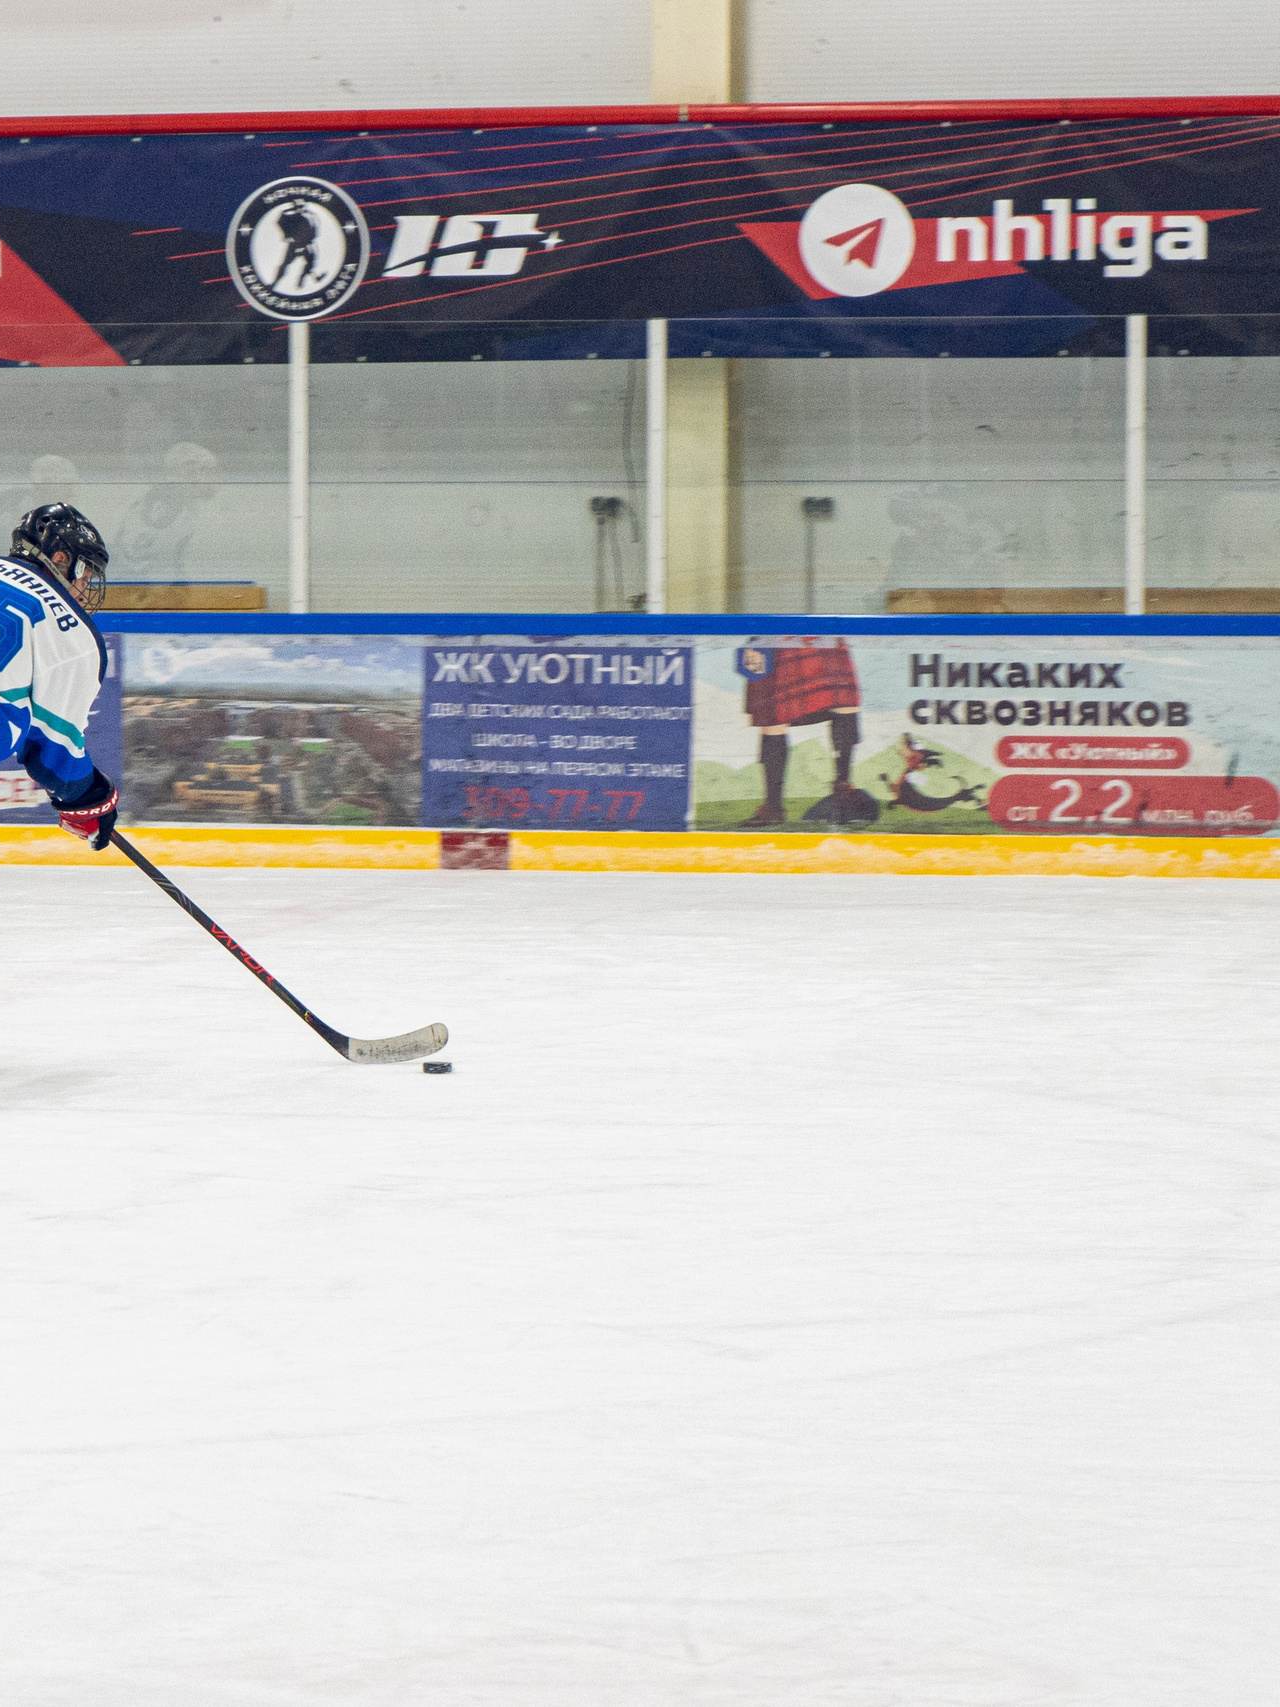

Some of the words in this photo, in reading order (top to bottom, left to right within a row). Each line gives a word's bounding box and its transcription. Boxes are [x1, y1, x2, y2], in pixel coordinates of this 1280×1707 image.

[936, 198, 1209, 278] nhliga
[432, 652, 495, 684] ЖК
[502, 648, 686, 686] УЮТНЫЙ
[909, 652, 1126, 689] Никаких
[428, 702, 466, 718] ДВА
[467, 703, 547, 718] ДЕТСКИХ
[548, 704, 595, 720] САДА
[596, 705, 693, 721] РАБОТАЮТ
[909, 698, 1193, 727] сквозняков
[472, 733, 539, 748] ШКОЛА
[549, 734, 579, 750] ВО
[577, 735, 639, 751] ДВОРЕ
[1008, 742, 1054, 760] ЖК
[551, 761, 625, 777] ПЕРВОМ
[627, 763, 687, 778] ЭТАЖЕ
